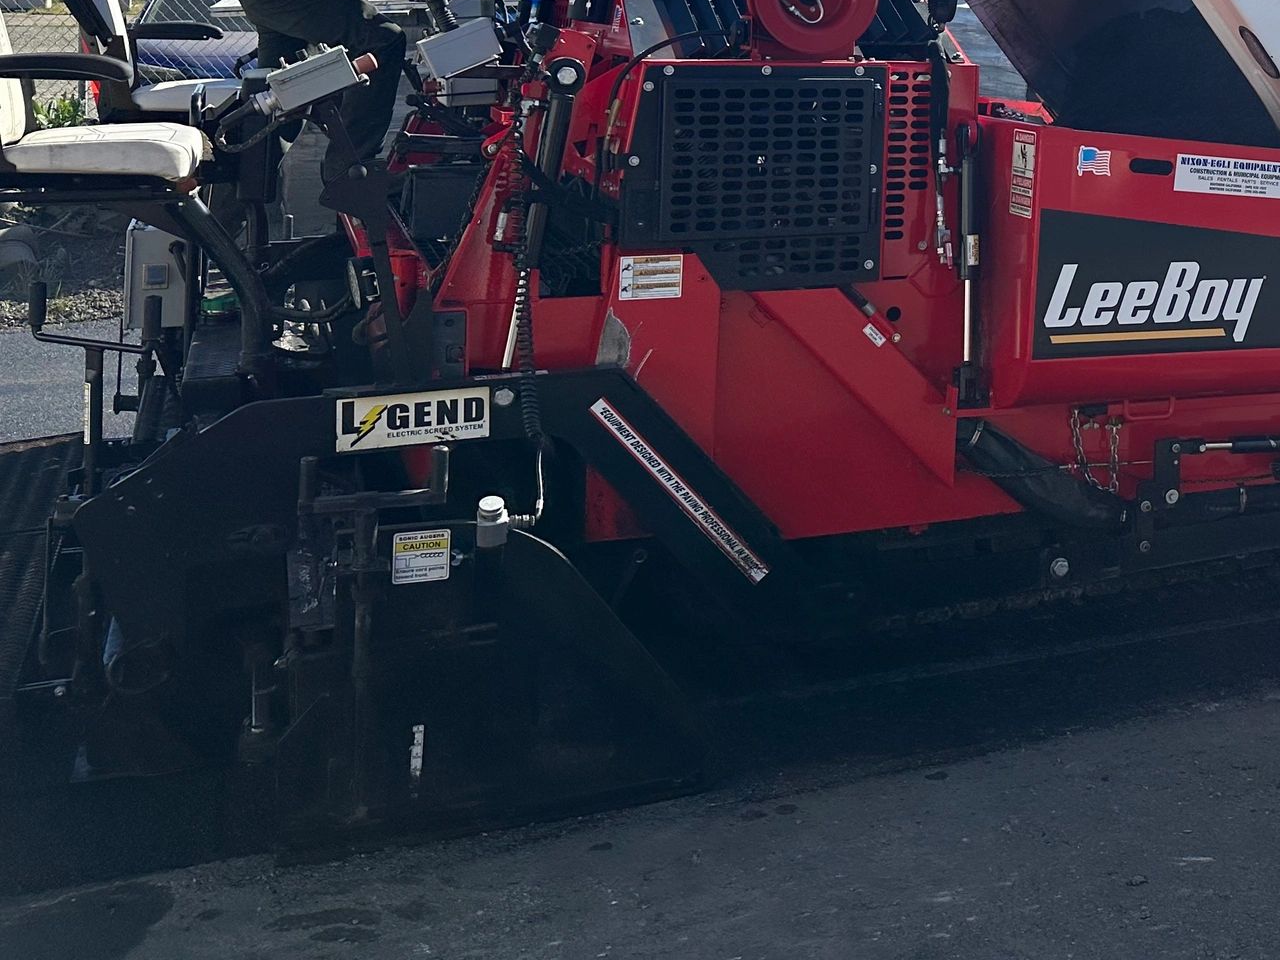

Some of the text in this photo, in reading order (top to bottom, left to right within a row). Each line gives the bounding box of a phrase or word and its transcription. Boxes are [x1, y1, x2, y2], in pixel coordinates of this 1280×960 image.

[1180, 156, 1231, 169] NIXON-EGLI
[1189, 167, 1227, 176] CONSTRUCTION
[1233, 171, 1260, 179] MUNICIPAL
[1043, 261, 1264, 342] LeeBoy
[341, 397, 485, 444] LGEND
[387, 429, 422, 438] ELECTRIC
[630, 440, 661, 468] DESIGNED
[656, 466, 675, 483] WITH
[670, 480, 685, 494] THE
[679, 491, 703, 513] PAVING
[698, 511, 738, 551] PROFESSIONAL
[734, 546, 747, 556] IN
[402, 541, 441, 550] CAUTION
